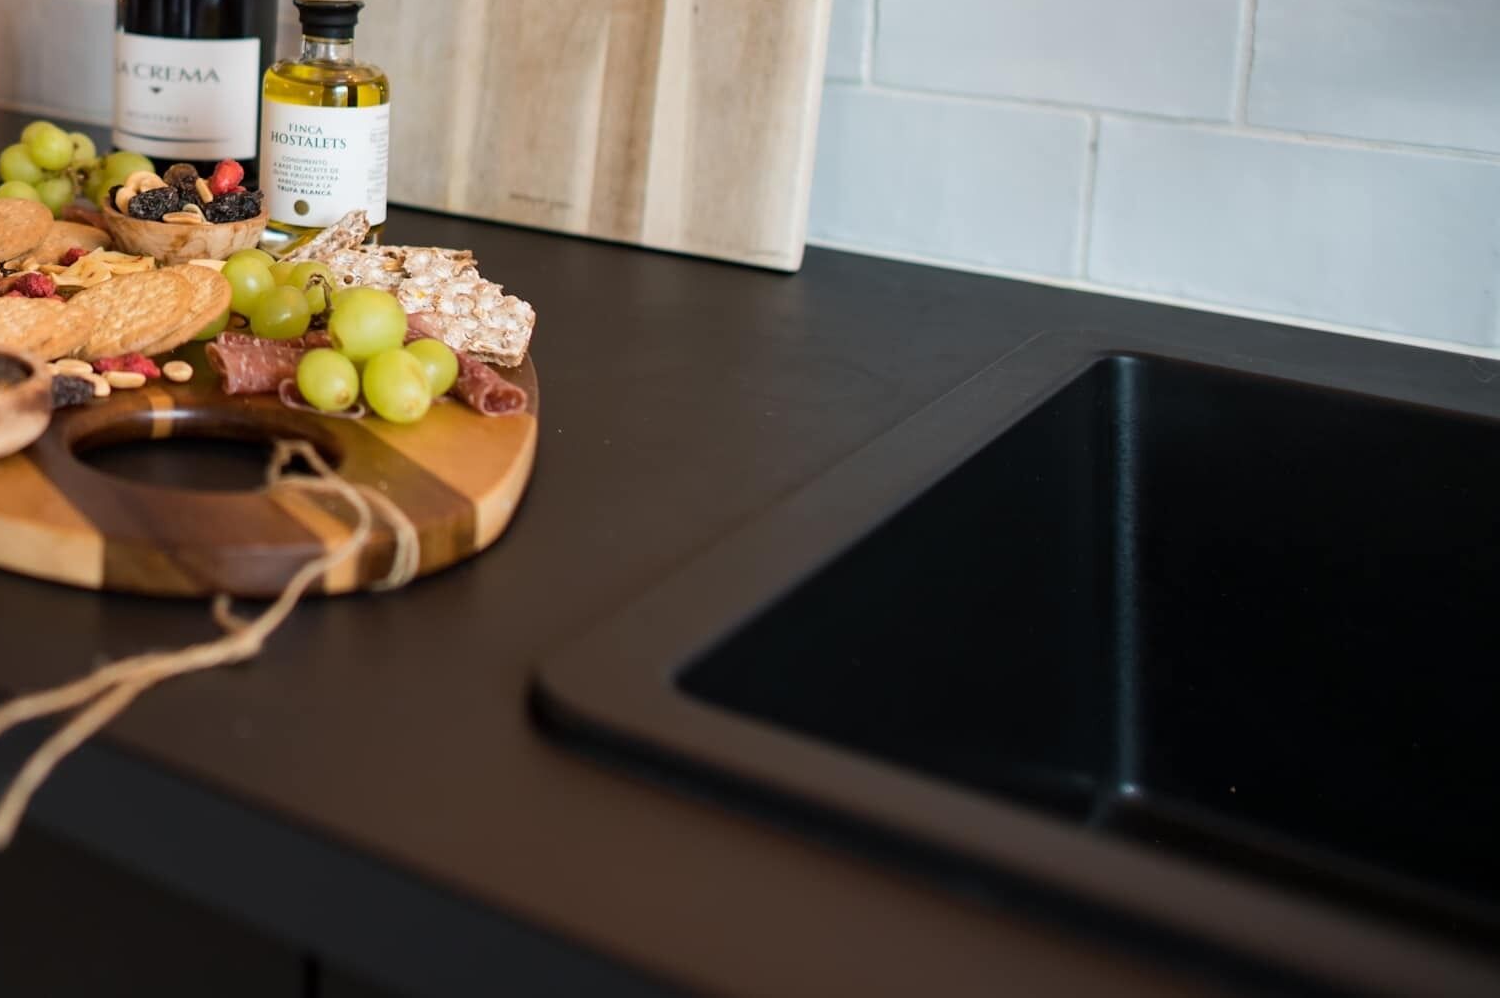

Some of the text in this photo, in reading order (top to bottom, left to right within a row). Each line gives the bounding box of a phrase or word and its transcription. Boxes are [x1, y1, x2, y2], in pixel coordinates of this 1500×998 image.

[133, 62, 220, 83] CREMA
[288, 122, 323, 135] FINCA
[271, 131, 347, 149] HOSTALETS
[281, 156, 328, 165] CONDIMENTO
[277, 184, 332, 196] TRUFA BLANCA
